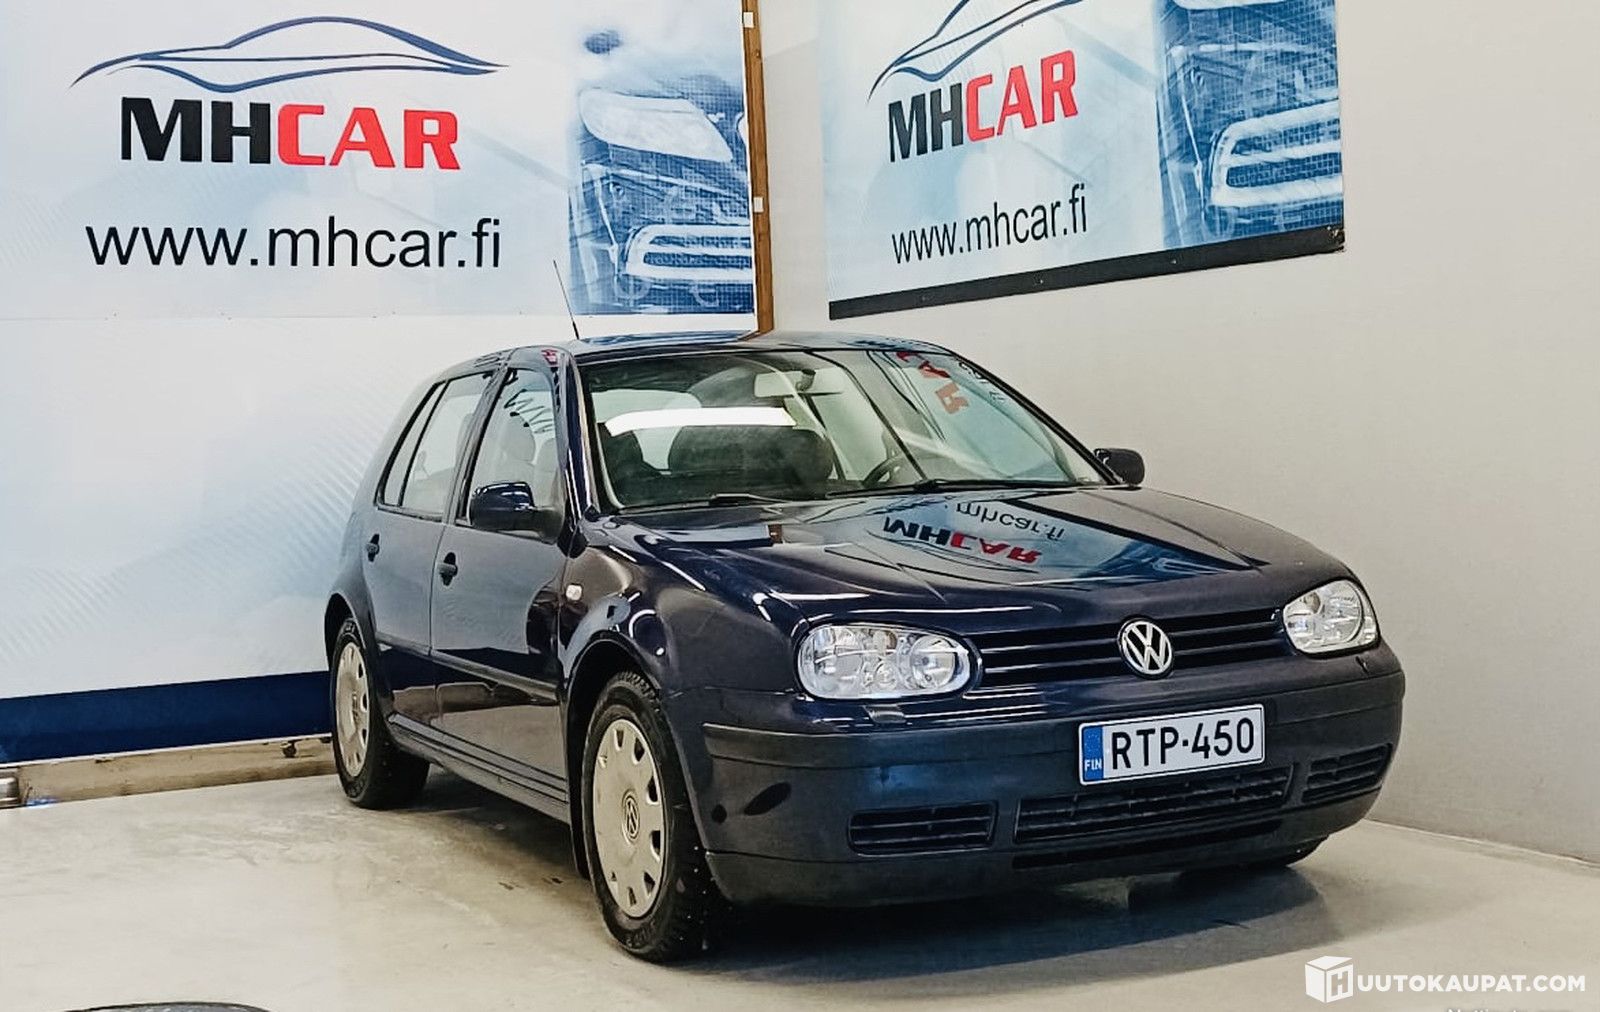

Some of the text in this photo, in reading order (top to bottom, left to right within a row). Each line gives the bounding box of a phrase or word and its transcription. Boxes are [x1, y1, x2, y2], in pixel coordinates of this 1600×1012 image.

[121, 96, 461, 170] MHCAR
[888, 50, 1079, 163] MHCAR
[85, 215, 501, 268] www.mhcar.fi
[892, 183, 1087, 264] www.mhcar.fi
[1084, 758, 1102, 771] FIN
[1111, 717, 1255, 770] RTP-450
